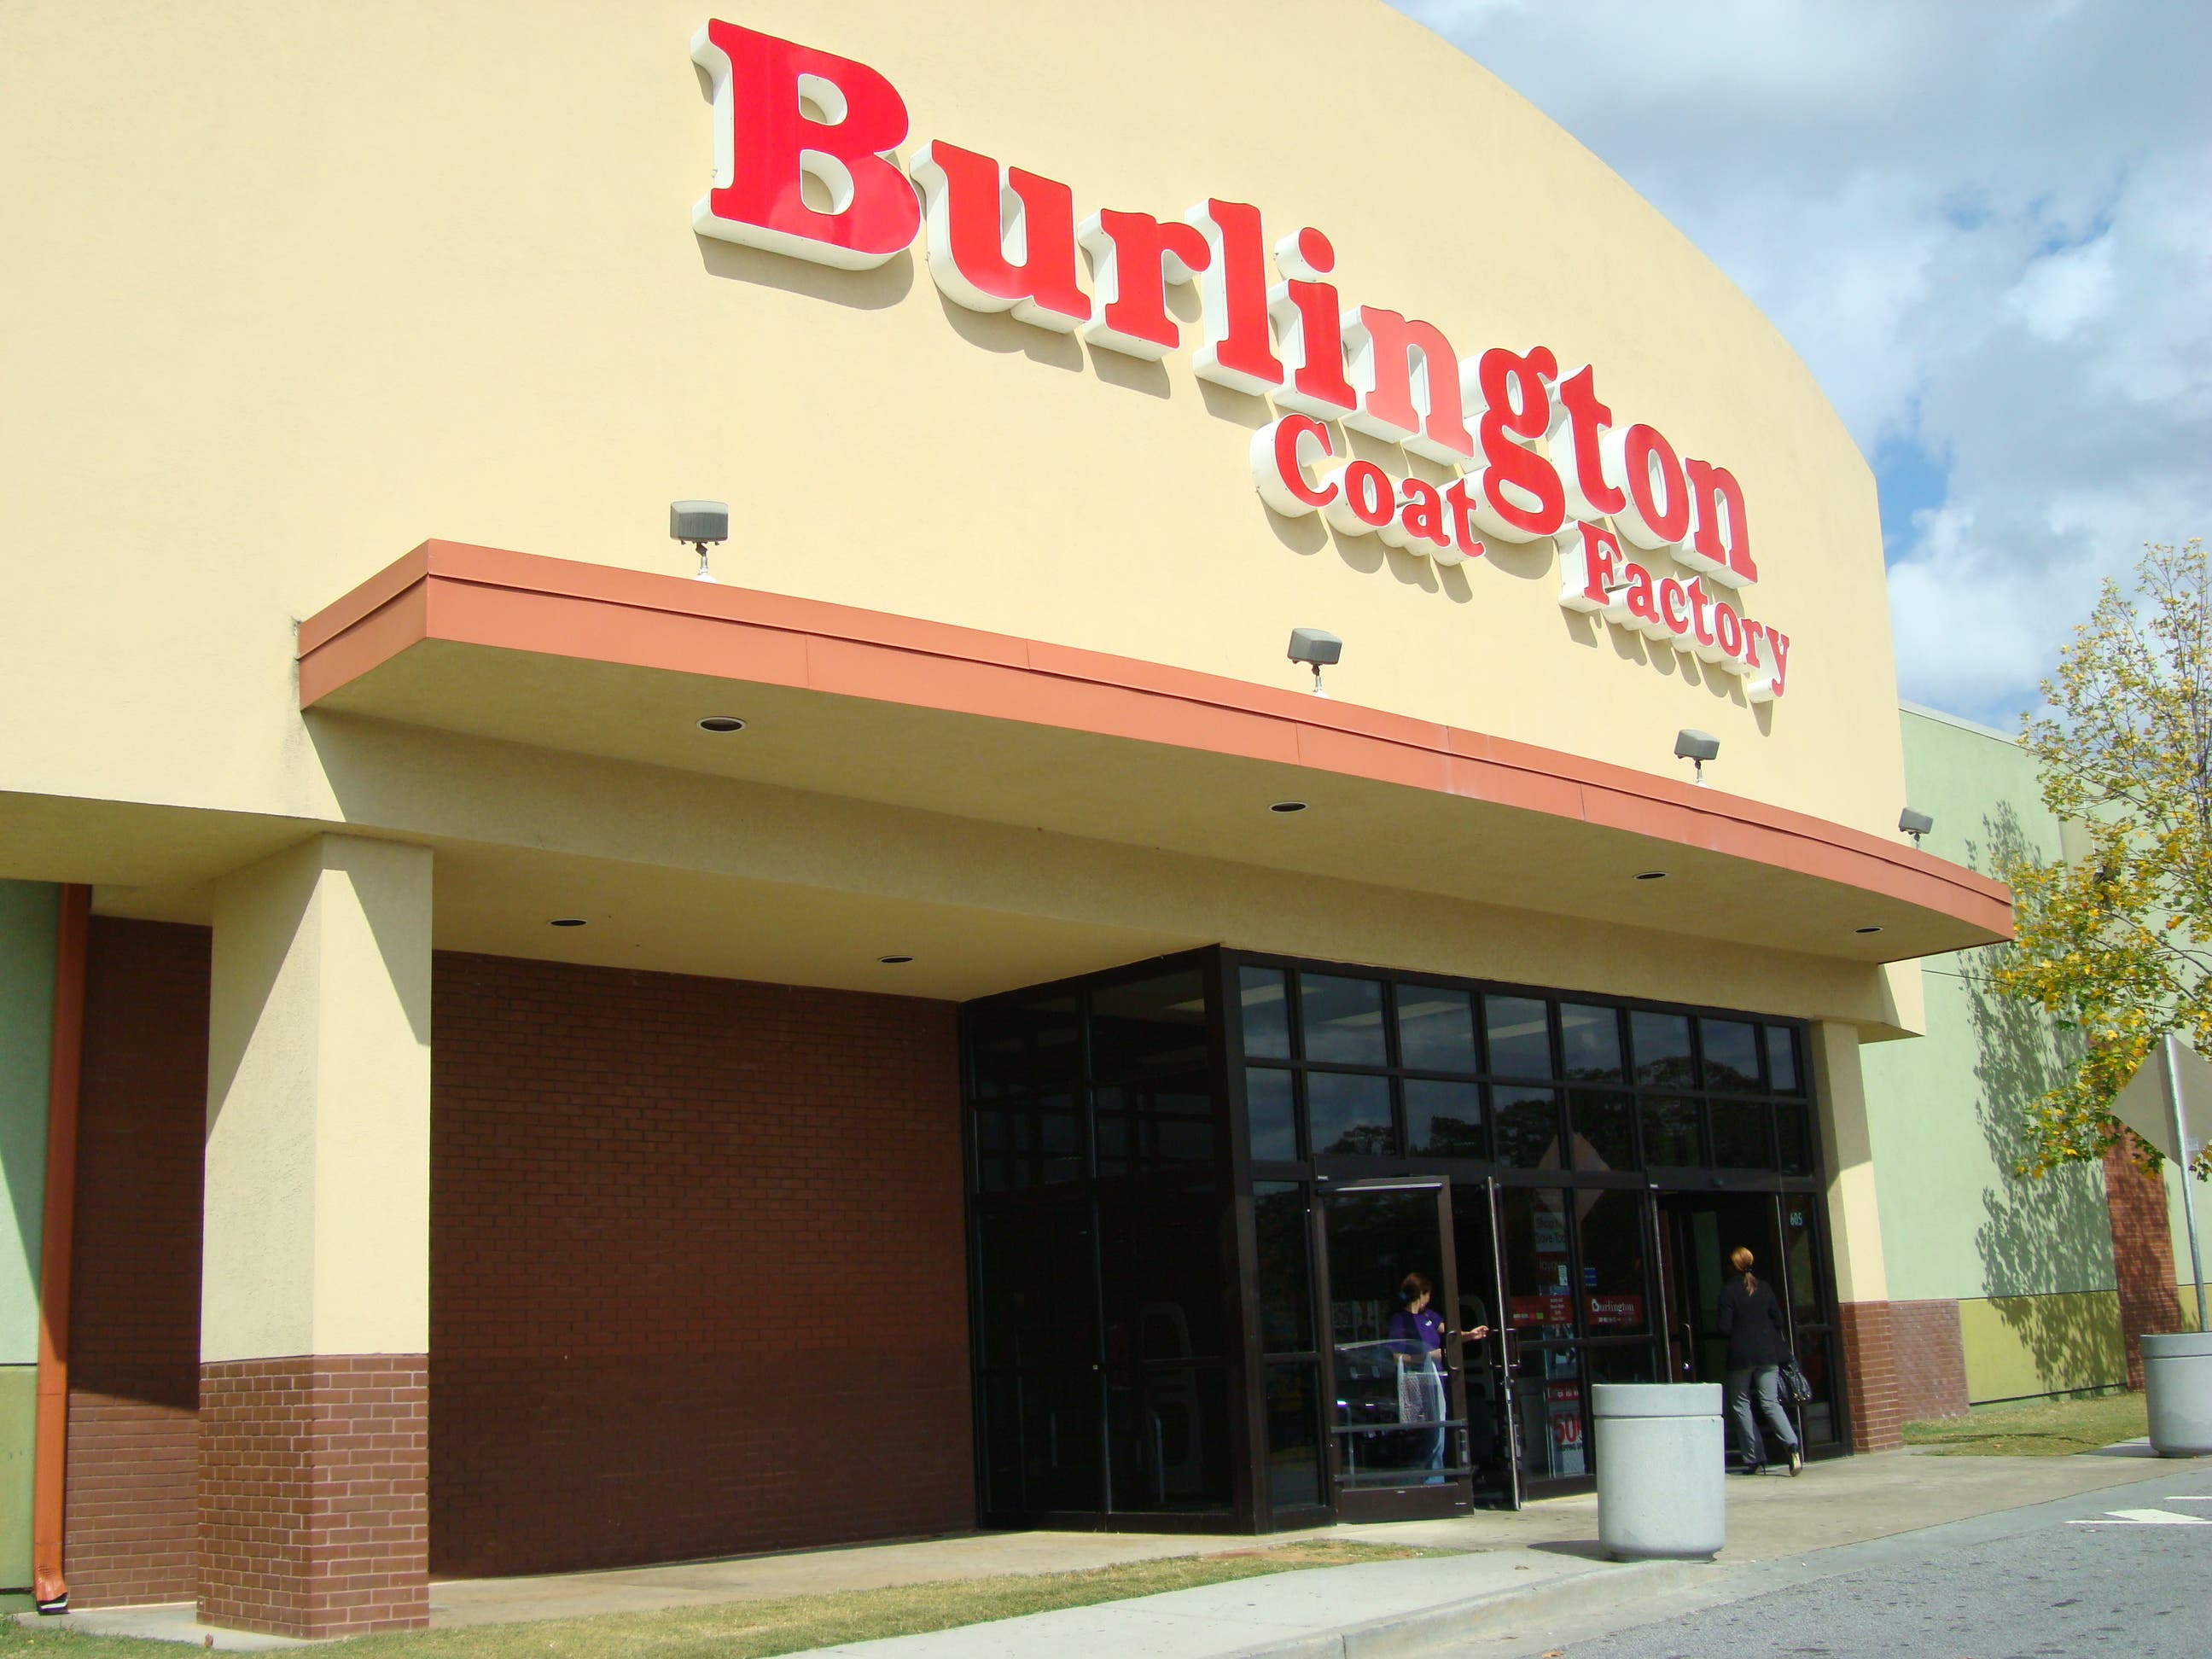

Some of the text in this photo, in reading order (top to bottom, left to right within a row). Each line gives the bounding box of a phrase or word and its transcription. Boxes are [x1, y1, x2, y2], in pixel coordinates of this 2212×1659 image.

[707, 19, 1758, 582] Burlington
[1274, 413, 1485, 558] Coat
[1577, 520, 1790, 697] Factory
[1591, 1298, 1635, 1315] Burlington
